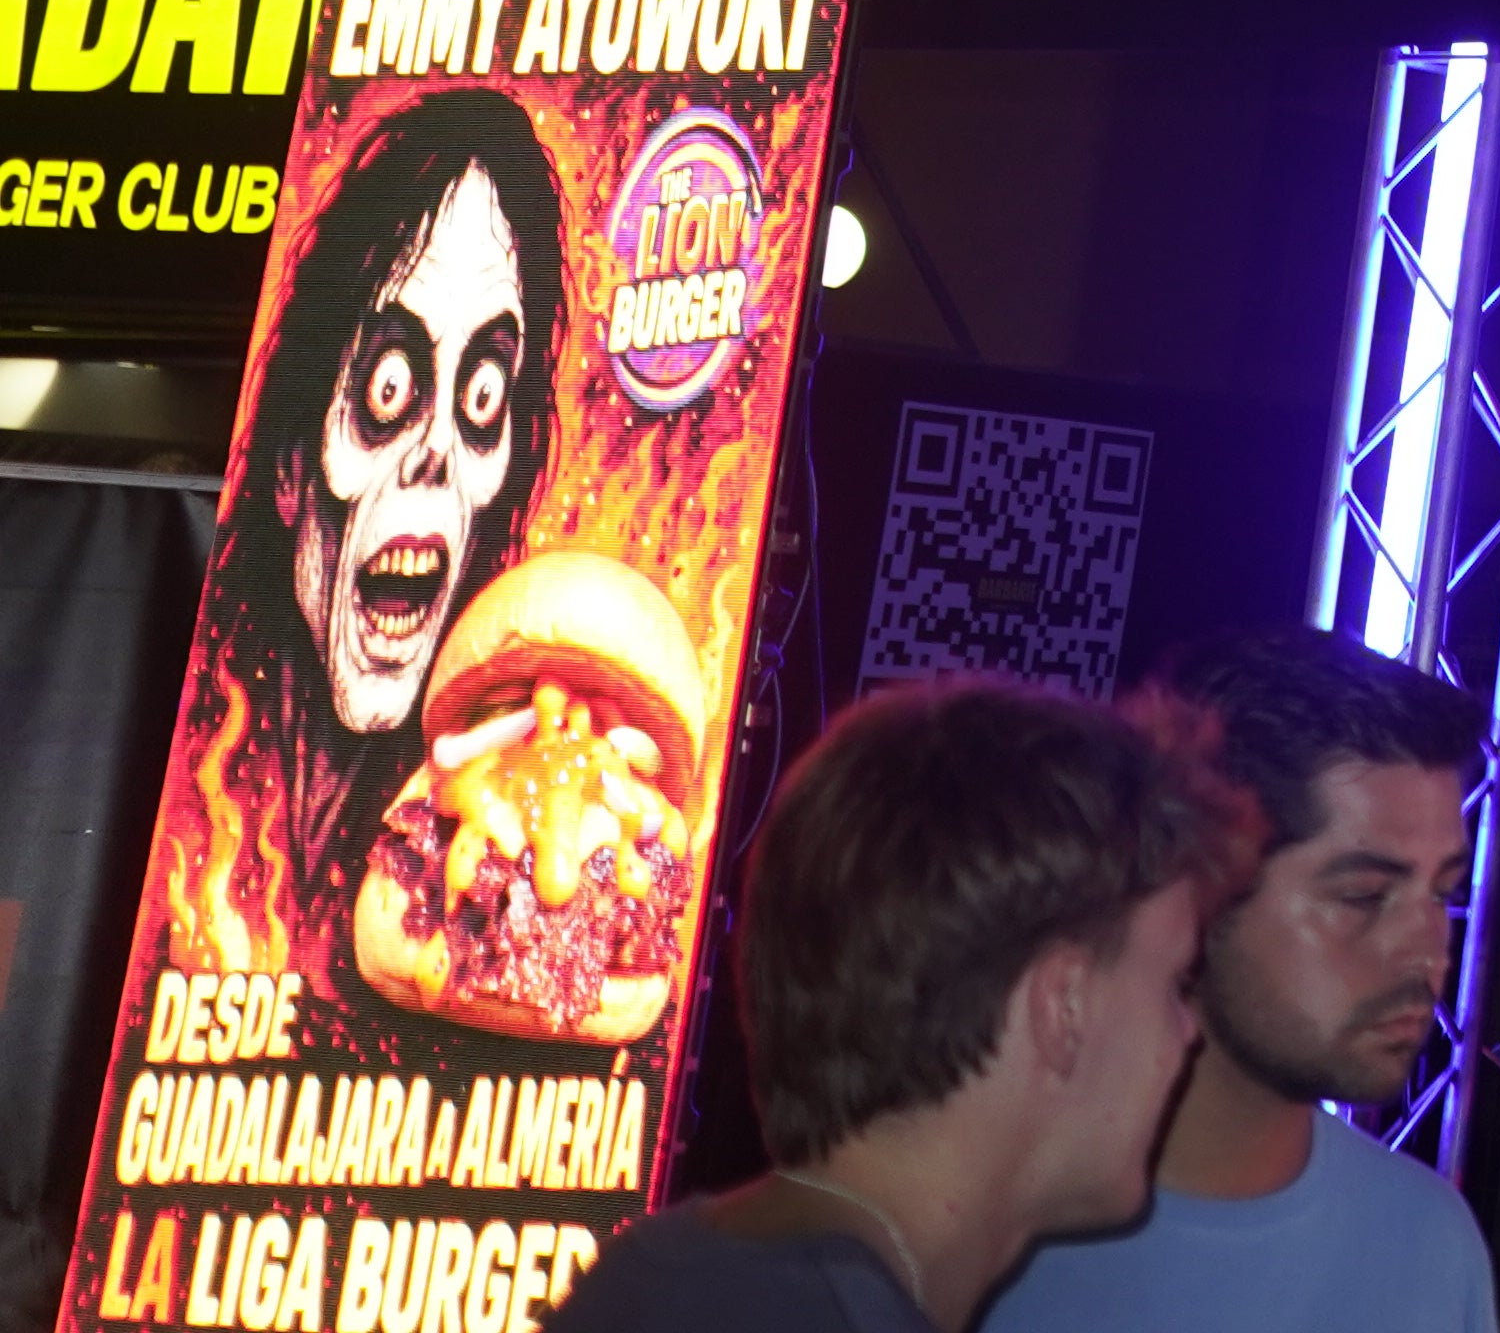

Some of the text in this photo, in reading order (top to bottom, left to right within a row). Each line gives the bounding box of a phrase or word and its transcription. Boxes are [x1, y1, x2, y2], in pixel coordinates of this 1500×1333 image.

[117, 161, 280, 234] CLUB
[660, 167, 693, 204] THE
[635, 190, 747, 279] LION
[608, 269, 747, 353] BURGER
[145, 970, 302, 1064] DESDE
[115, 1047, 647, 1190] GUADALAJARA A ALMERÍA
[99, 1210, 178, 1323] LA
[185, 1212, 328, 1332] LIGA
